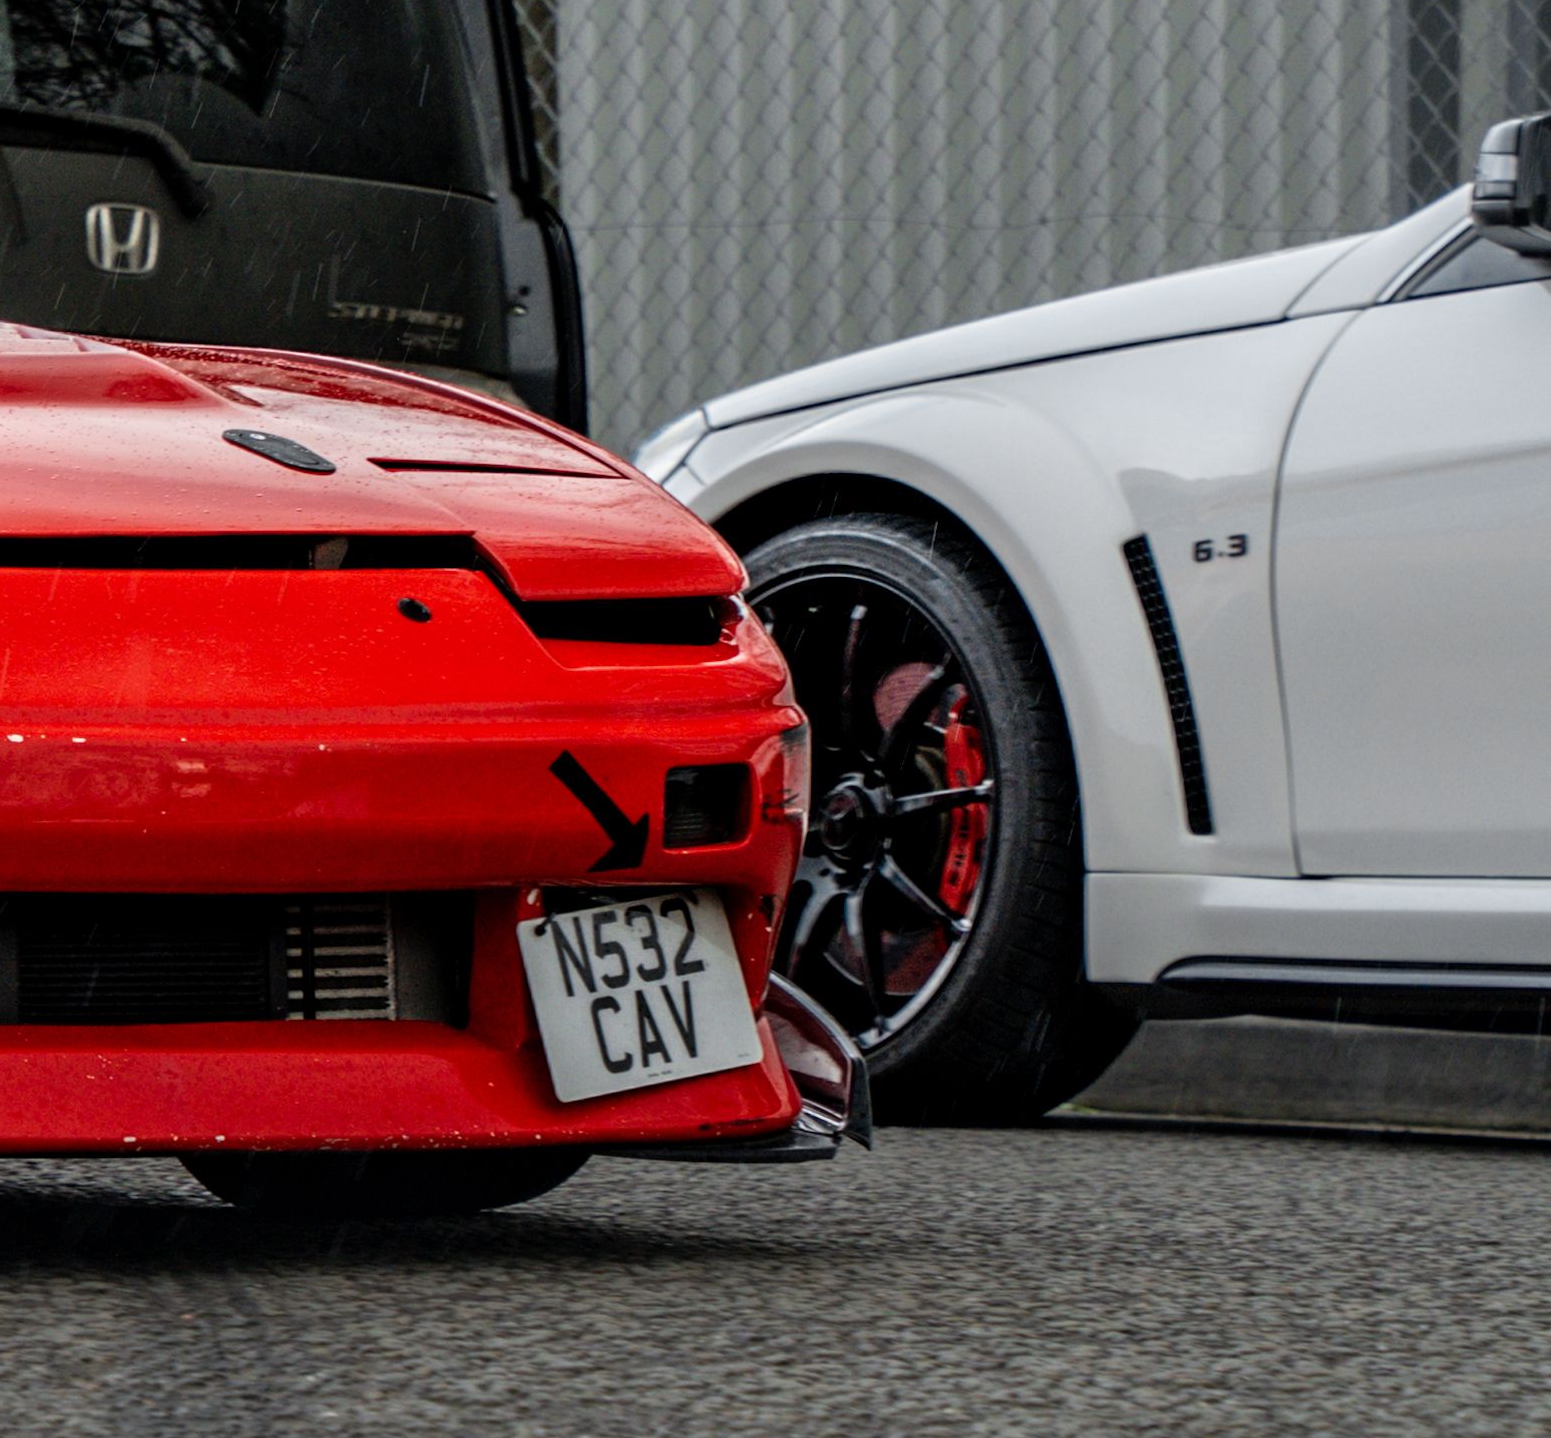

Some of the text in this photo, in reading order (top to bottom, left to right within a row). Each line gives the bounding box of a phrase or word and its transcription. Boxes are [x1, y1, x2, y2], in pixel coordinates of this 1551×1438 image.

[1191, 533, 1250, 563] 6.3
[550, 897, 706, 998] N532
[591, 980, 699, 1074] CAV
